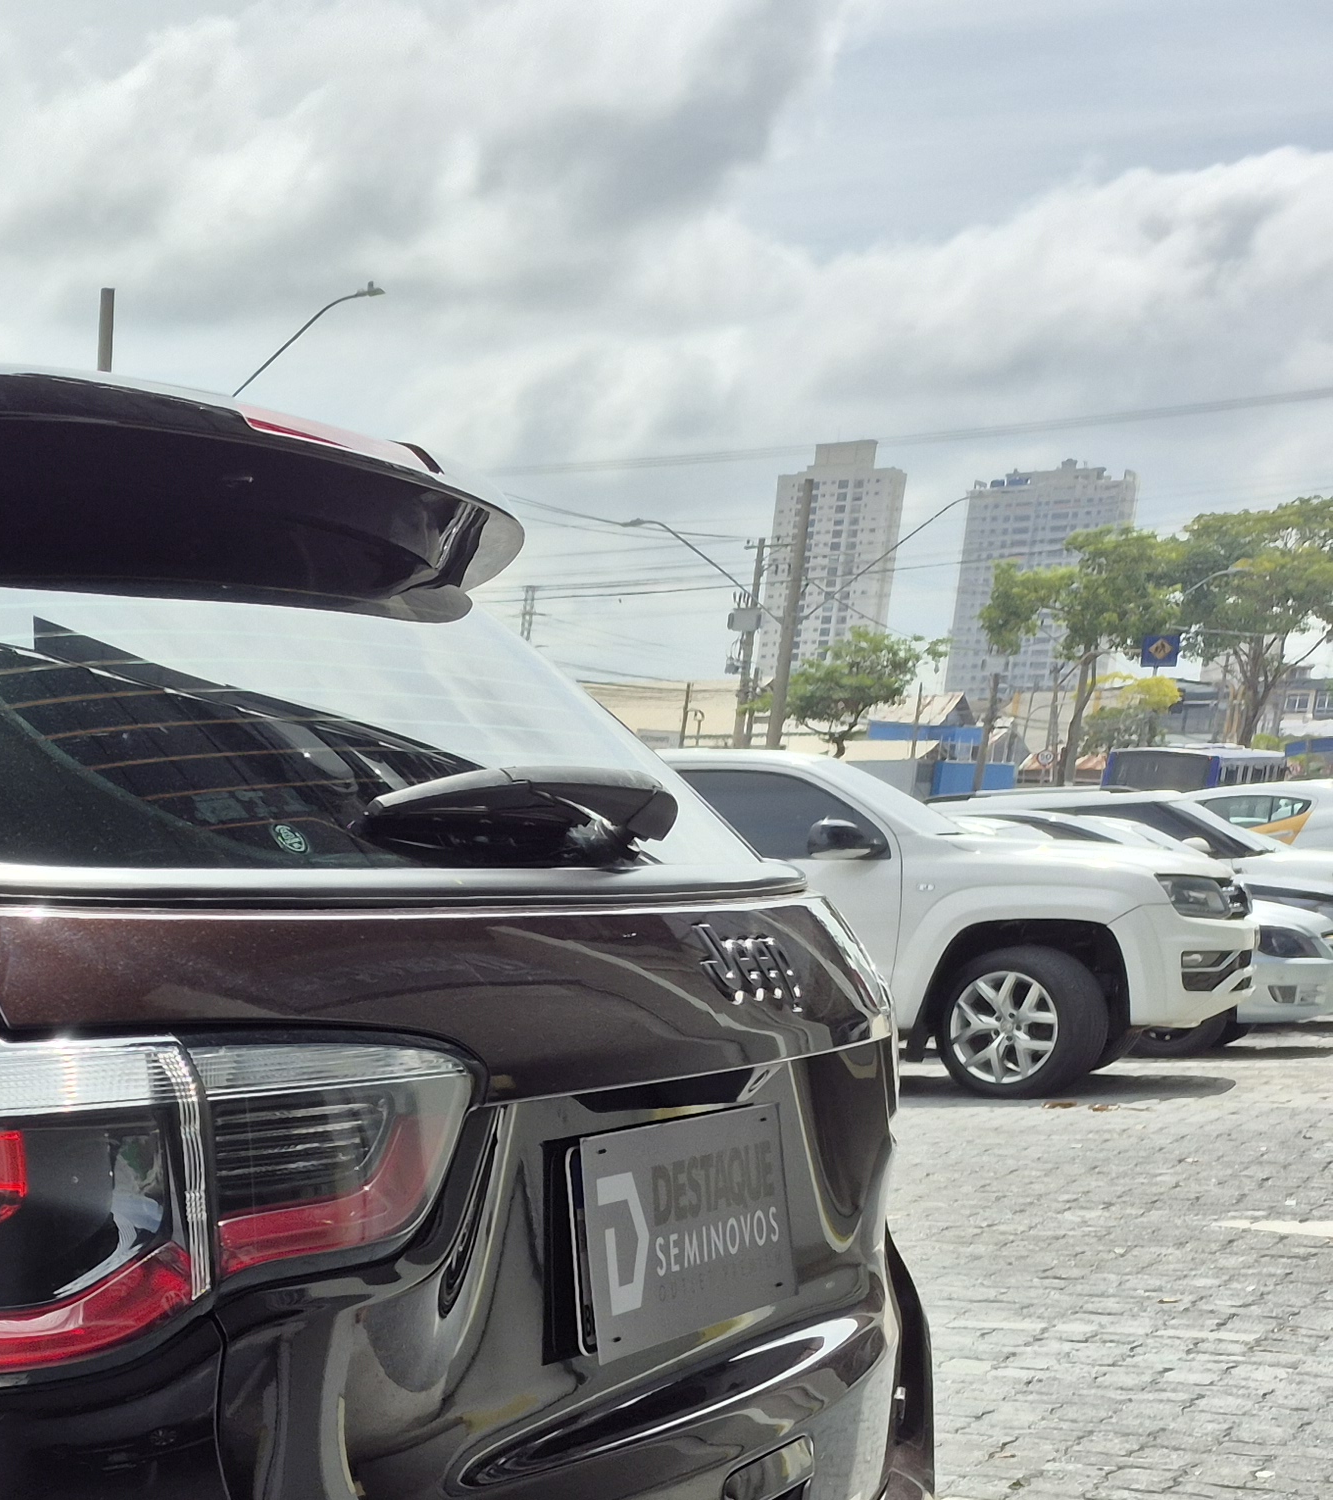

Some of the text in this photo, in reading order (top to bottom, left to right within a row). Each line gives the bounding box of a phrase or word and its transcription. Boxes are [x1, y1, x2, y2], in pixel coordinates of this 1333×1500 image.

[692, 921, 803, 1013] Jeep
[651, 1140, 775, 1227] DESTAQUE
[655, 1206, 779, 1277] SEMINOVOS
